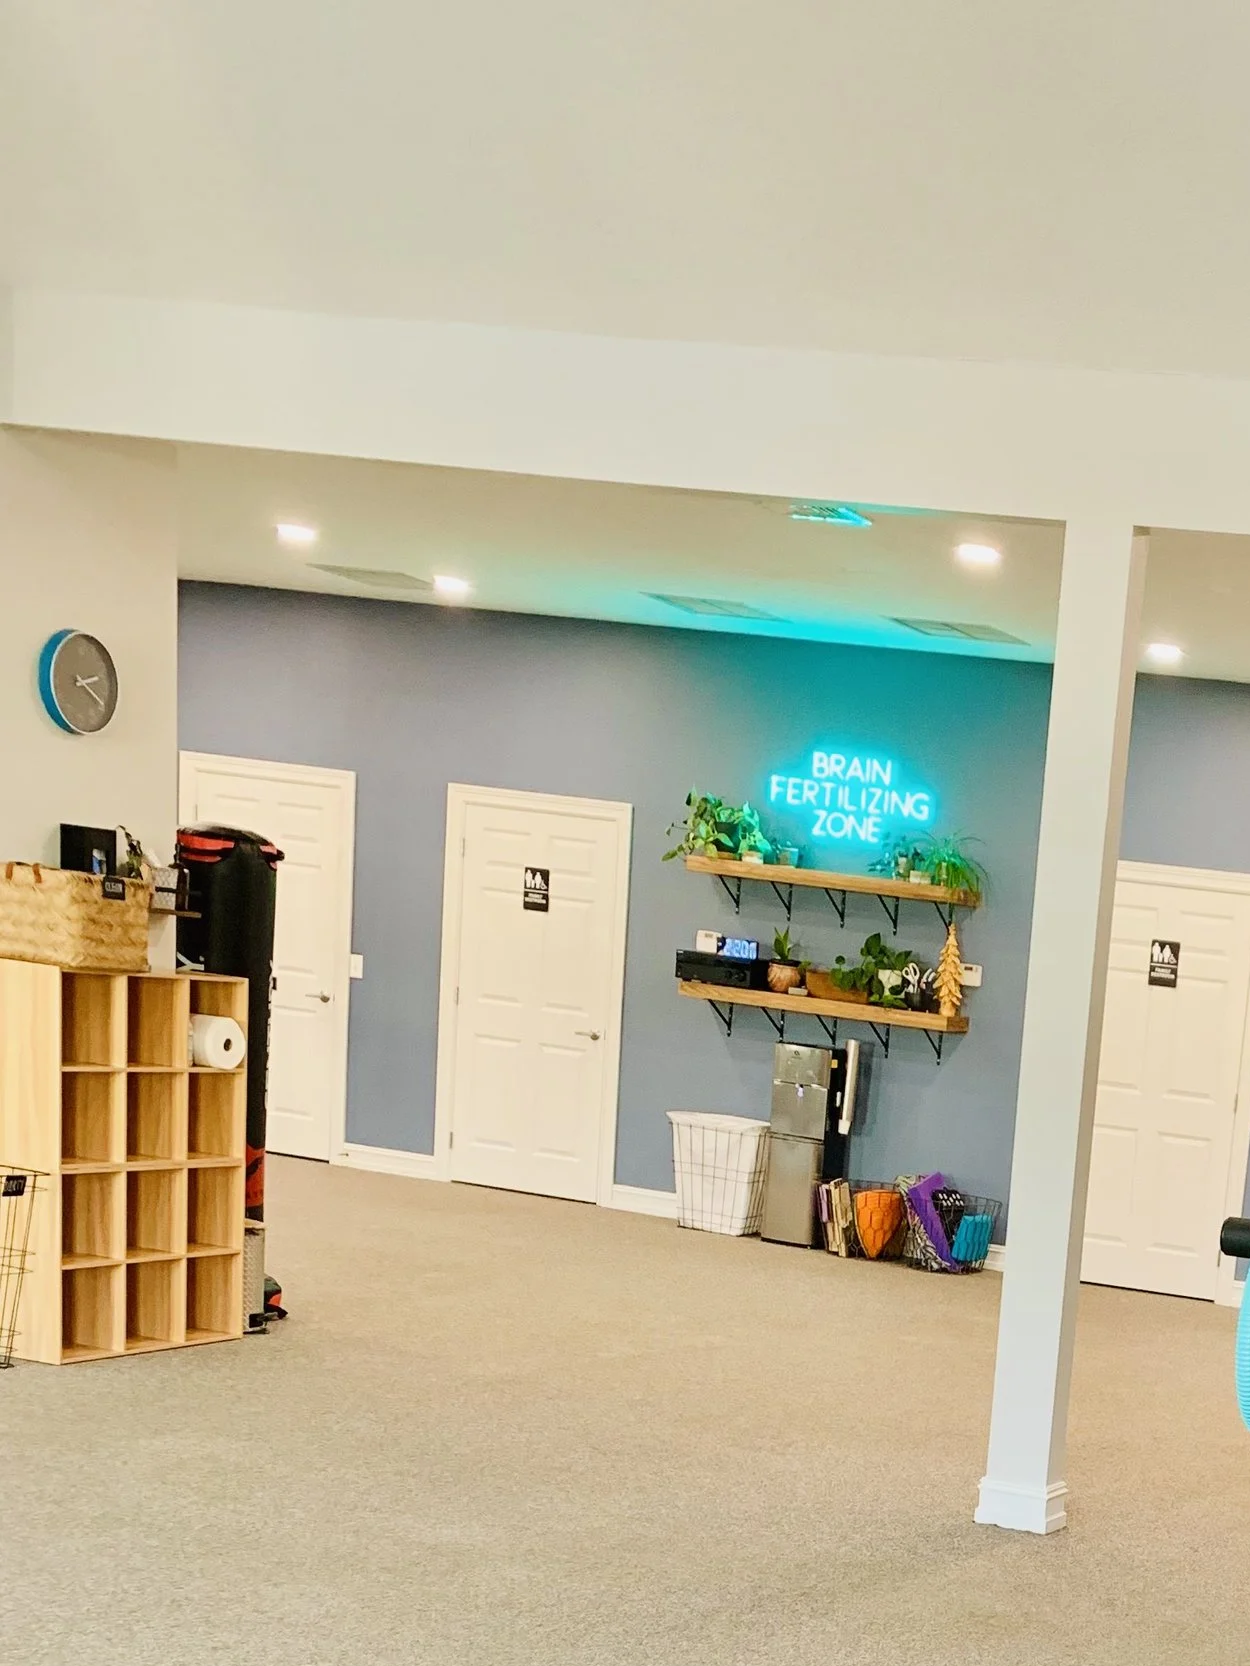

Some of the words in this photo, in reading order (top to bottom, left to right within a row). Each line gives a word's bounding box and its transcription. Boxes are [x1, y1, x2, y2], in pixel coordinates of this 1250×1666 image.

[812, 751, 892, 787] BRAIN
[769, 774, 930, 821] FERTILIZING
[811, 809, 882, 844] ZONE
